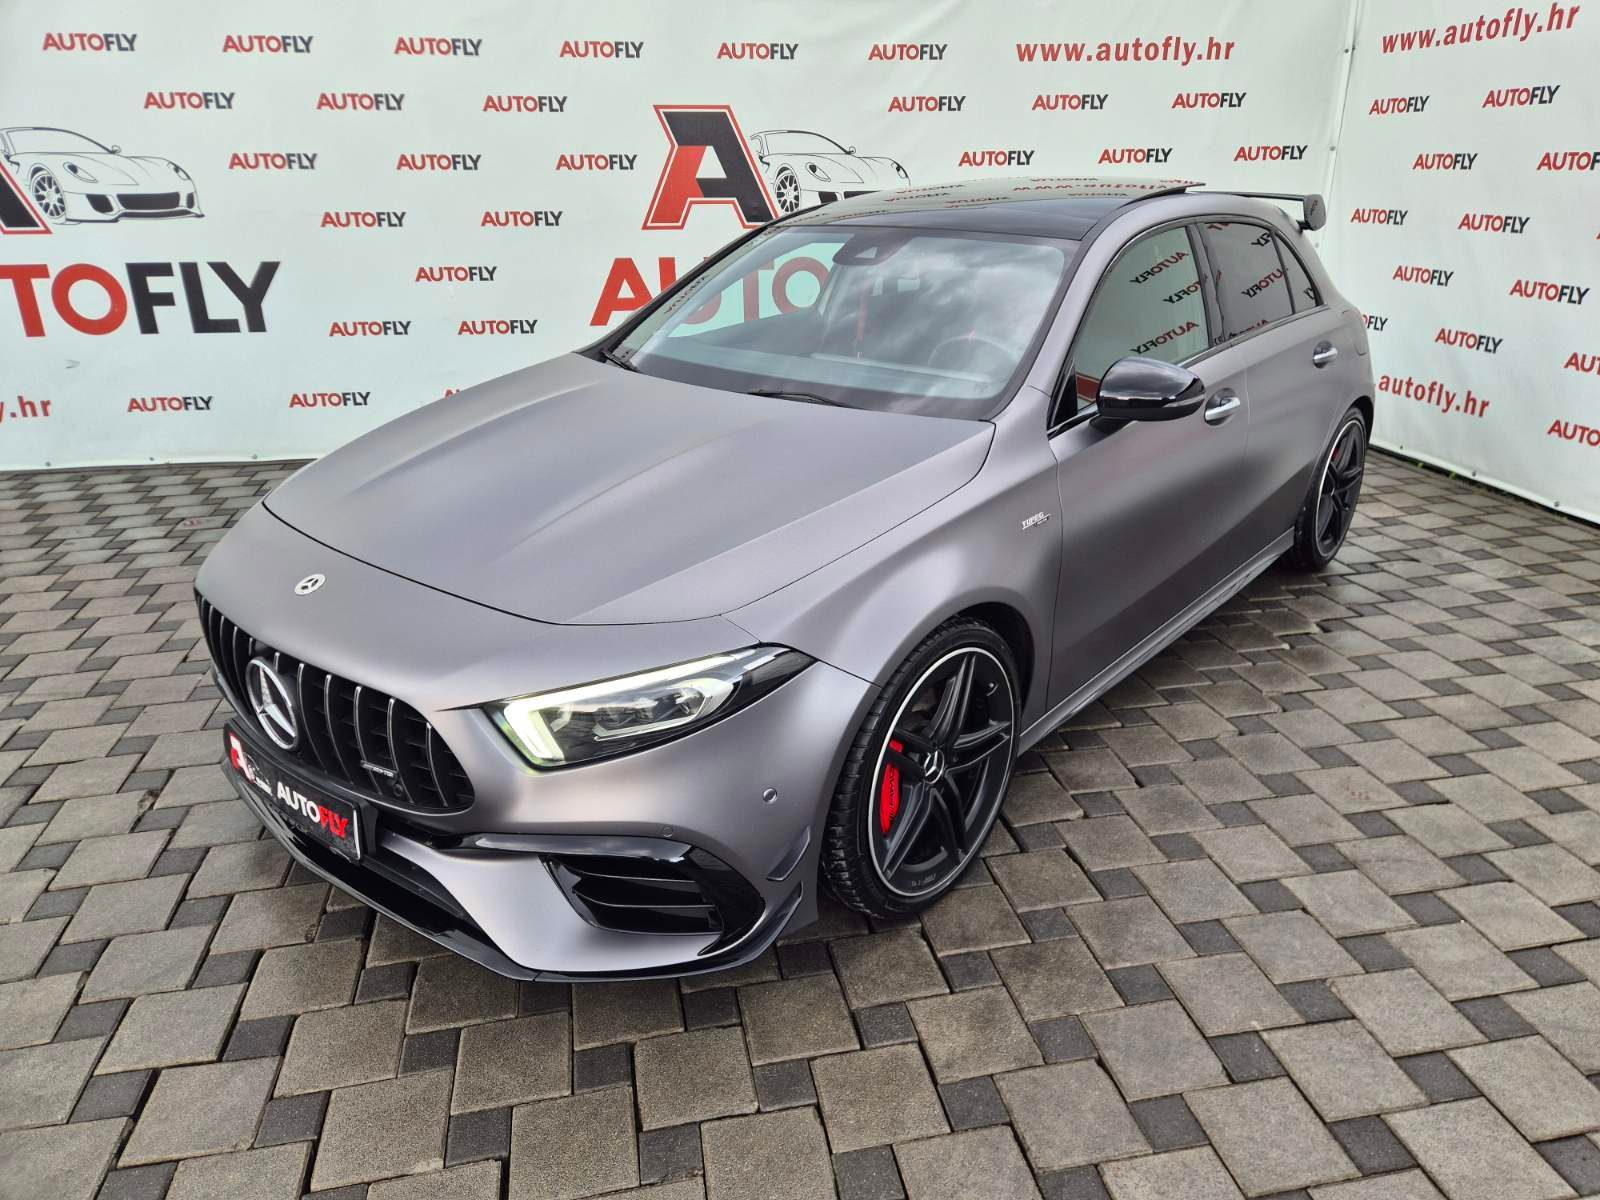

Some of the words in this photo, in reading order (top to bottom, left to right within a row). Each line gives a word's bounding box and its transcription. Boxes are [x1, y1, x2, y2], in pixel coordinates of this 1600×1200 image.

[1383, 2, 1580, 53] www.autofly.hr
[43, 33, 137, 51] AUTOFLY
[223, 35, 313, 53] AUTOFLY
[395, 37, 482, 56] AUTOFLY
[560, 41, 644, 58] AUTOFLY
[717, 43, 799, 60] AUTOFLY
[868, 44, 947, 60] AUTOFLY
[1016, 36, 1234, 66] www.autofly.hr
[144, 92, 234, 109] AUTOFLY
[317, 93, 404, 110] AUTOFLY
[483, 96, 567, 112] AUTOFLY
[888, 96, 966, 112] AUTOFLY
[1032, 94, 1108, 110] AUTOFLY
[1172, 92, 1246, 108] AUTOFLY
[1482, 85, 1560, 108] AUTOFLY
[1369, 96, 1430, 115] AUTOFLY
[229, 153, 317, 169] AUTOFLY
[959, 150, 1035, 166] AUTOFLY
[1098, 148, 1173, 164] AUTOFLY
[1234, 145, 1308, 161] AUTOFLY
[1413, 153, 1478, 170] AUTOFLY
[397, 154, 481, 170] AUTOFLY
[556, 154, 637, 170] AUTOFLY
[321, 212, 406, 227] AUTOFLY
[481, 211, 563, 226] AUTOFLY
[1351, 208, 1408, 225] AUTOFLY
[1458, 214, 1530, 234] AUTOFLY
[415, 266, 497, 282] AUTOFLY
[1393, 266, 1454, 287] AUTOFLY
[0, 261, 280, 337] TOFLY
[1509, 280, 1590, 305] AUTOFLY
[329, 321, 411, 336] AUTOFLY
[458, 320, 538, 335] AUTOFLY
[1435, 328, 1503, 354] AUTOFLY
[128, 396, 212, 412] AUTOFLY
[289, 392, 370, 408] AUTOFLY
[1379, 376, 1489, 418] autofly.hr
[277, 781, 349, 839] AUTOFLY
